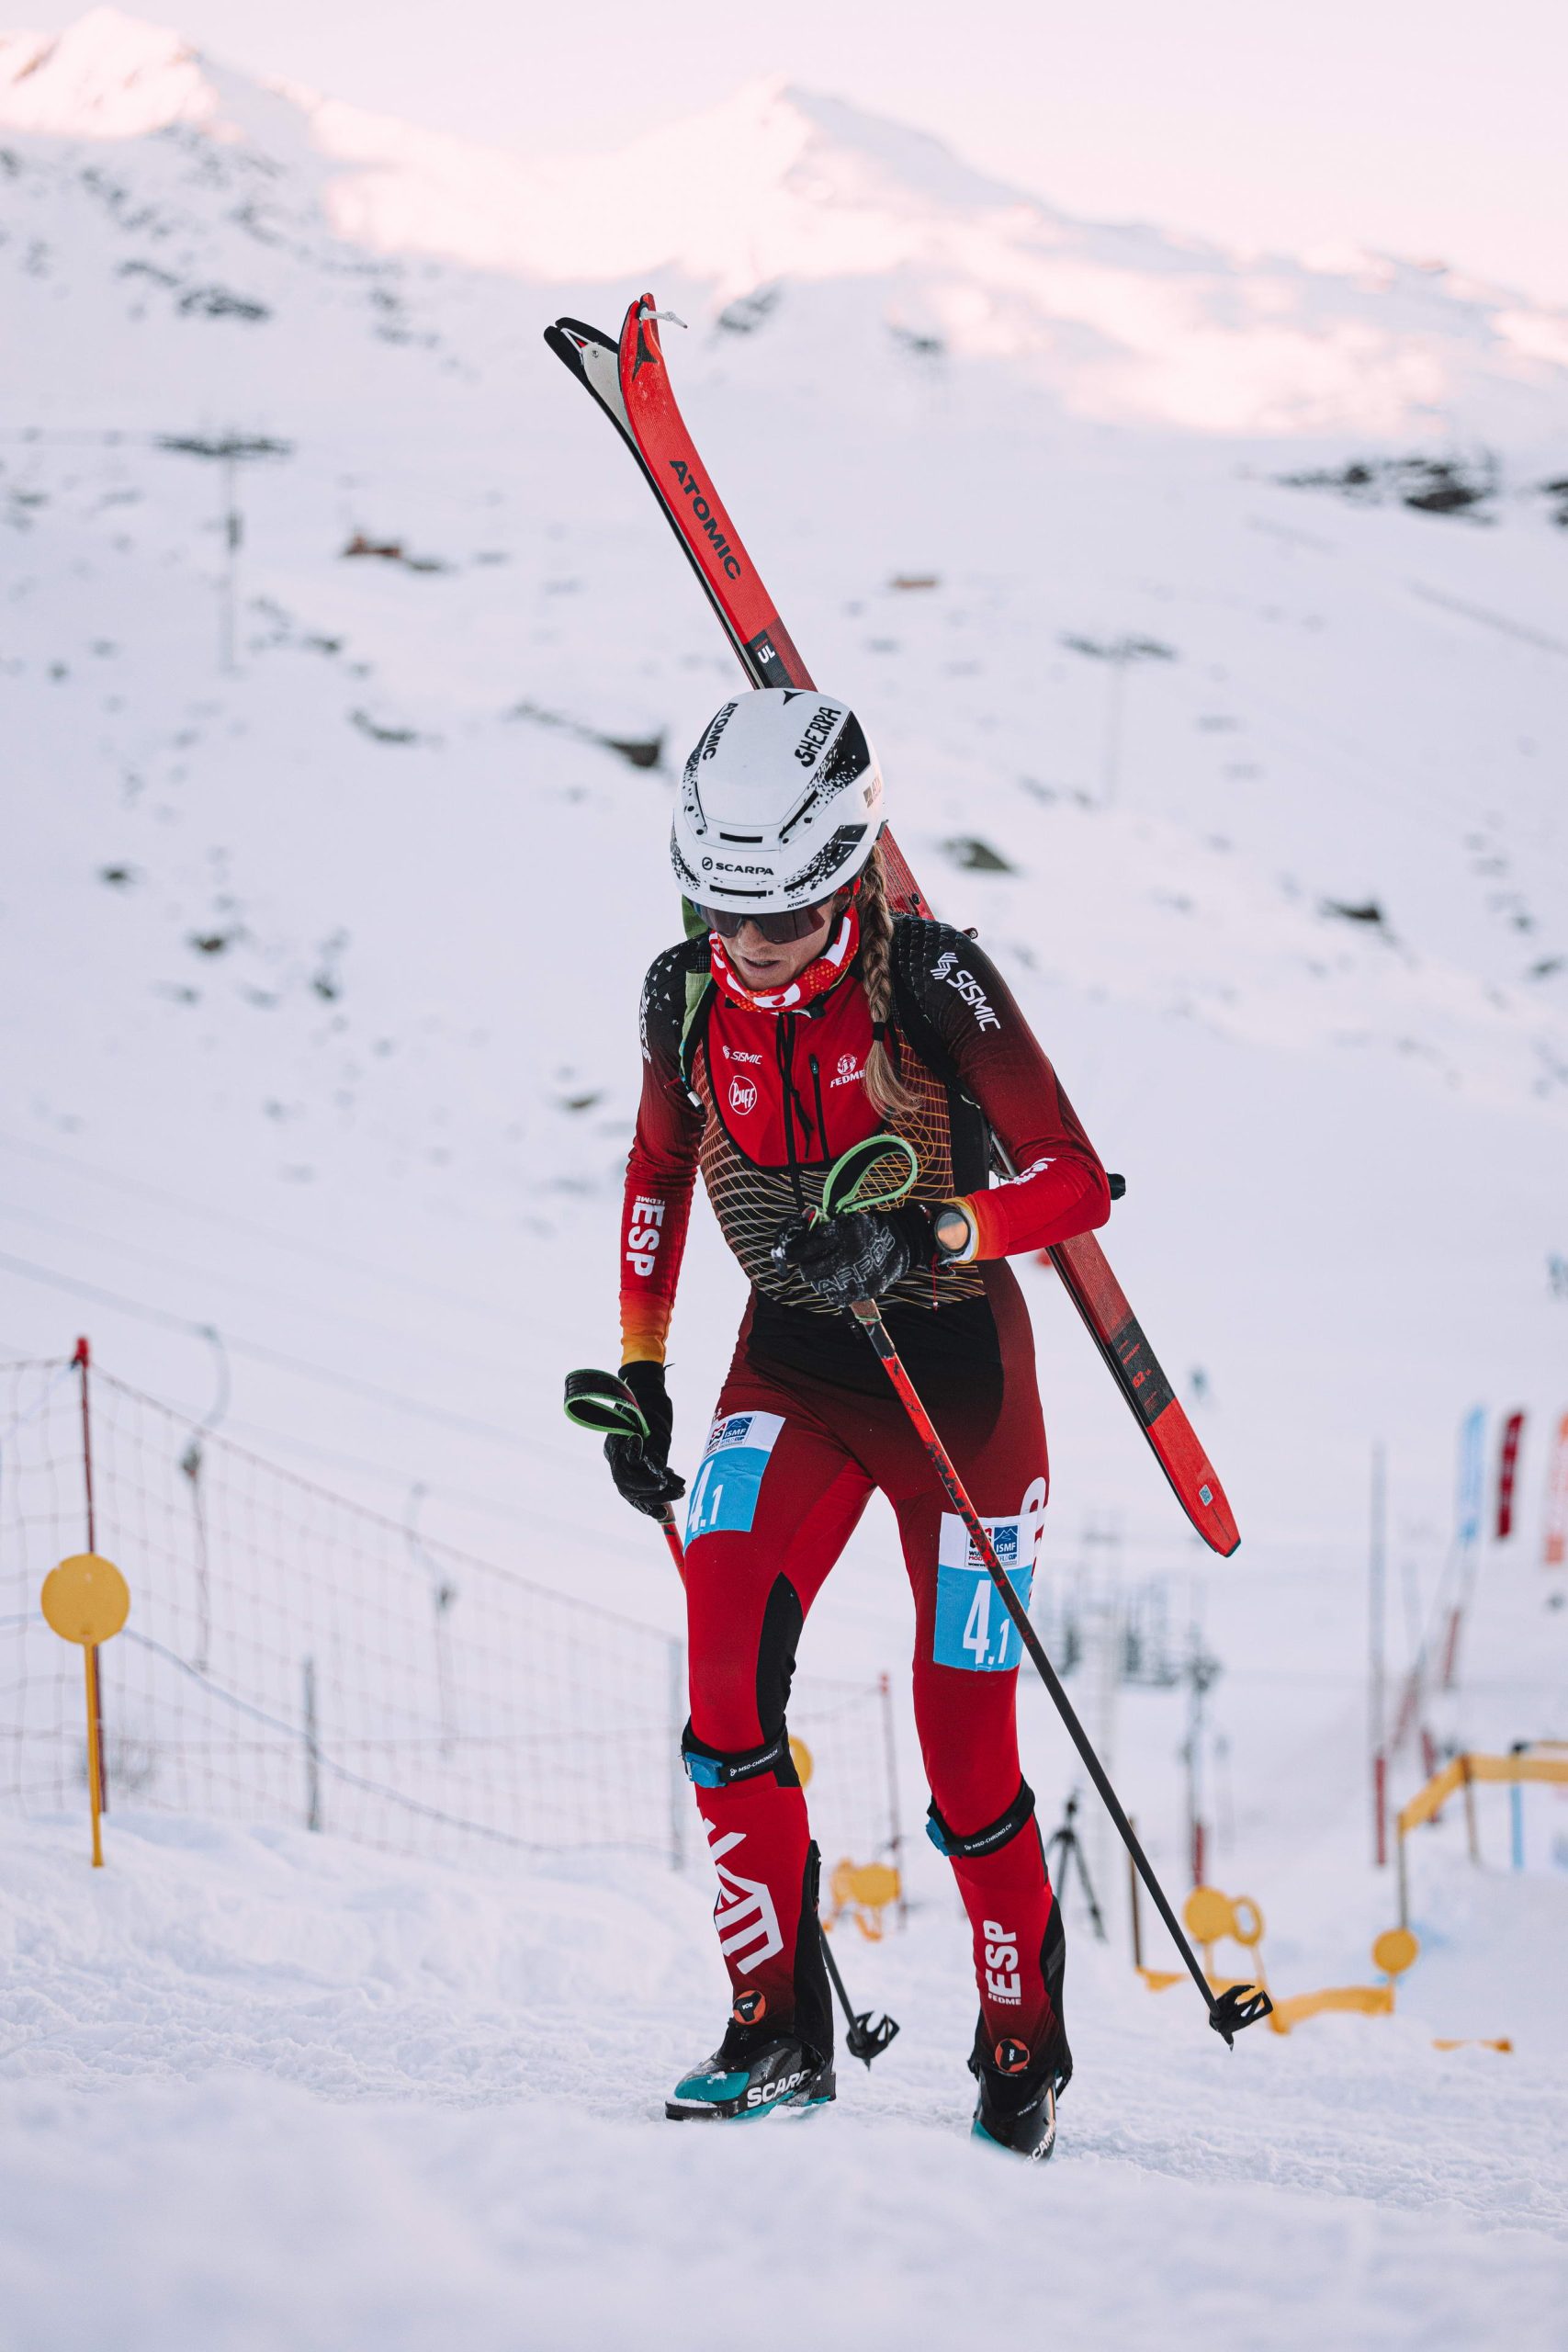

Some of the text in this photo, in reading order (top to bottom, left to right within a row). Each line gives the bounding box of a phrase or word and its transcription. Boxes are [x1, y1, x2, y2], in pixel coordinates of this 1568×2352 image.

[670, 460, 741, 580] ATOMIC
[758, 645, 776, 664] UL
[703, 703, 739, 761] ATOMIC
[795, 707, 841, 767] SHERPA
[716, 862, 774, 876] SCARPA
[787, 898, 810, 909] ATOMIC
[946, 970, 1000, 1032] SISMIC
[731, 1051, 762, 1065] SISMIC
[626, 1202, 665, 1277] ESP
[813, 1225, 896, 1294] ARPOS
[724, 1428, 747, 1438] ISMF
[688, 1459, 724, 1533] 4.1
[996, 1542, 1016, 1553] ISMF
[963, 1579, 1010, 1666] 4.1
[983, 1919, 1021, 1998] ESP
[987, 1992, 1022, 2007] FEDME
[747, 2068, 812, 2108] SCARP
